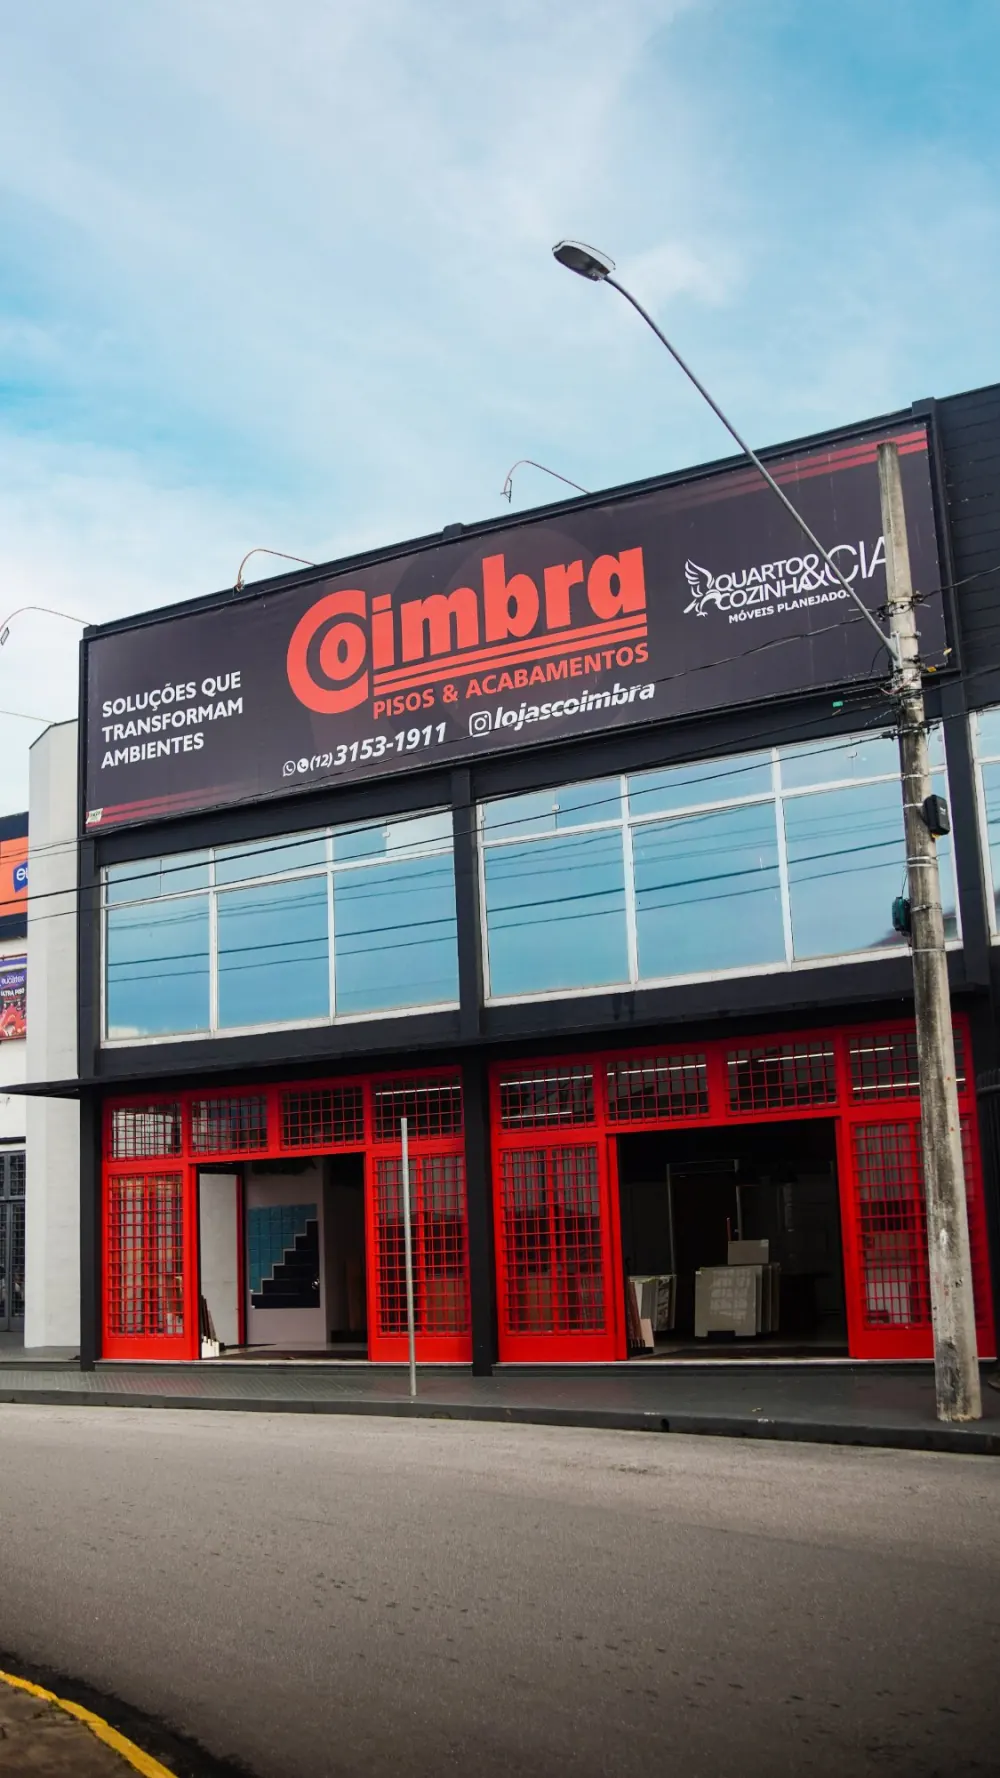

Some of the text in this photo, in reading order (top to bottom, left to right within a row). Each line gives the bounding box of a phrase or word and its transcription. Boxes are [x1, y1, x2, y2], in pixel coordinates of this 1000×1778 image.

[715, 557, 803, 592] QUARTO
[718, 572, 813, 611] COZINHA
[286, 547, 646, 714] Coimbra
[728, 605, 774, 624] MÓVEIS
[102, 671, 241, 718] SOLUÇÕES QUE
[373, 643, 649, 720] PISOS & ACABAMENTOS
[102, 697, 243, 743] TRANSFORMAM
[494, 682, 655, 731] lojascoimbra
[101, 732, 204, 769] AMBIENTES
